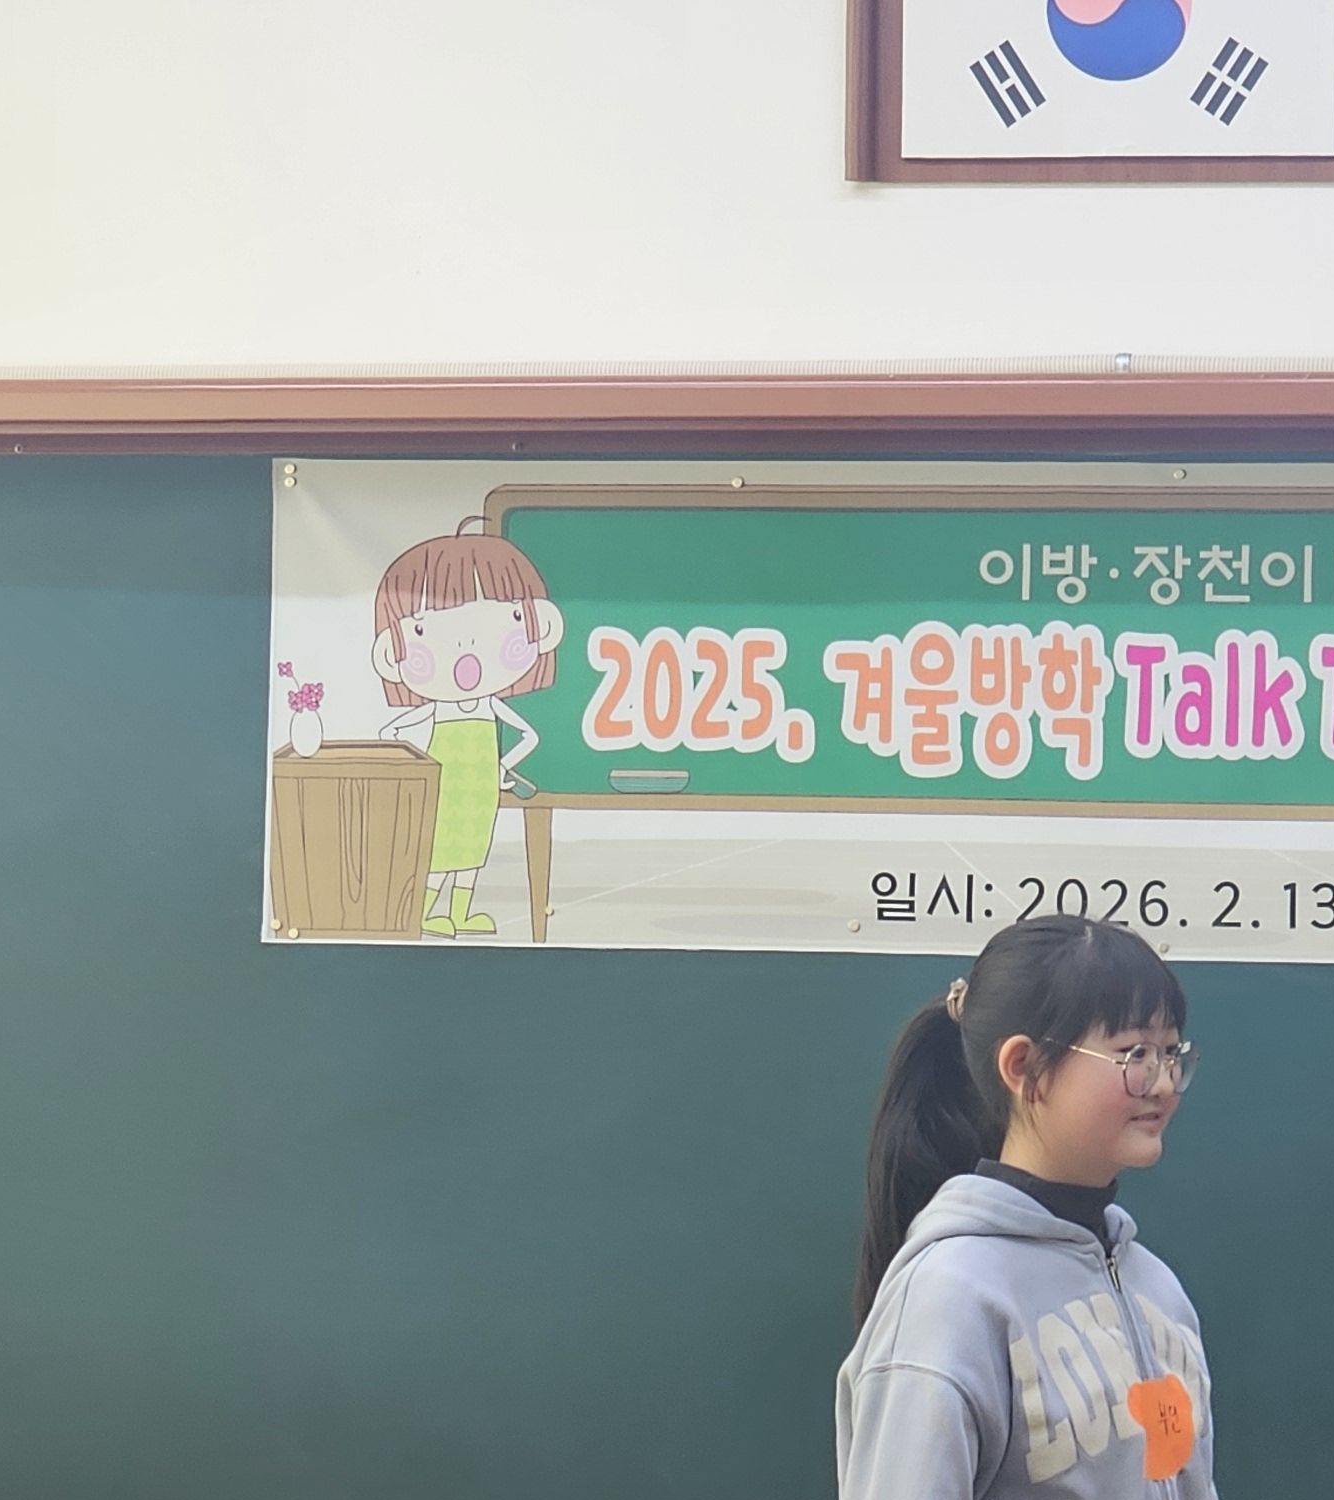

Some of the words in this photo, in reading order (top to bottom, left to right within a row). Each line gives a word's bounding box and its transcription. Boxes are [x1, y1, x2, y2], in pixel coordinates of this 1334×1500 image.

[979, 543, 1313, 606] 이방·장천이
[593, 637, 803, 752] 2025.
[835, 632, 1103, 768] 겨울방학
[1126, 641, 1295, 748] Talk
[871, 871, 994, 924] 일시:
[1017, 876, 1188, 928] 2026.
[1211, 880, 1261, 928] 2.
